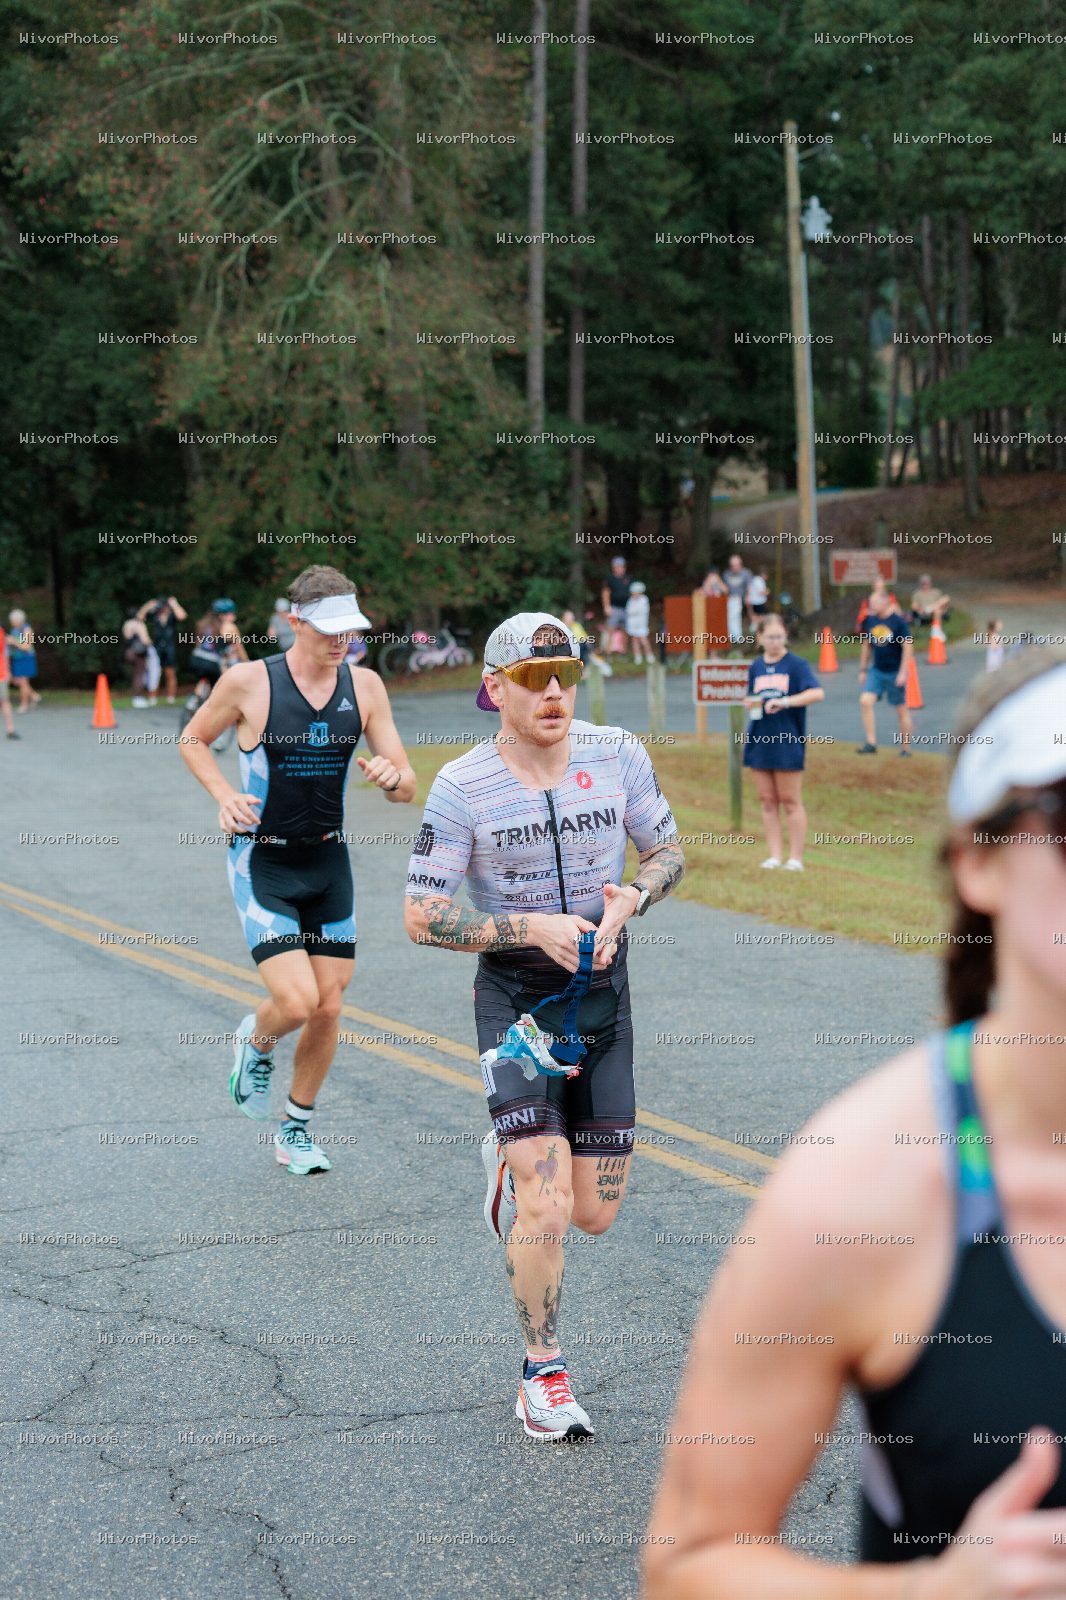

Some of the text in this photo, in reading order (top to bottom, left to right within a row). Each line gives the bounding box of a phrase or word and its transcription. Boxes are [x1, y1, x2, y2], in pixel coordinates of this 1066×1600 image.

[491, 807, 617, 848] TRIMARNI
[407, 873, 446, 888] ARNI
[494, 1106, 534, 1132] ARNI
